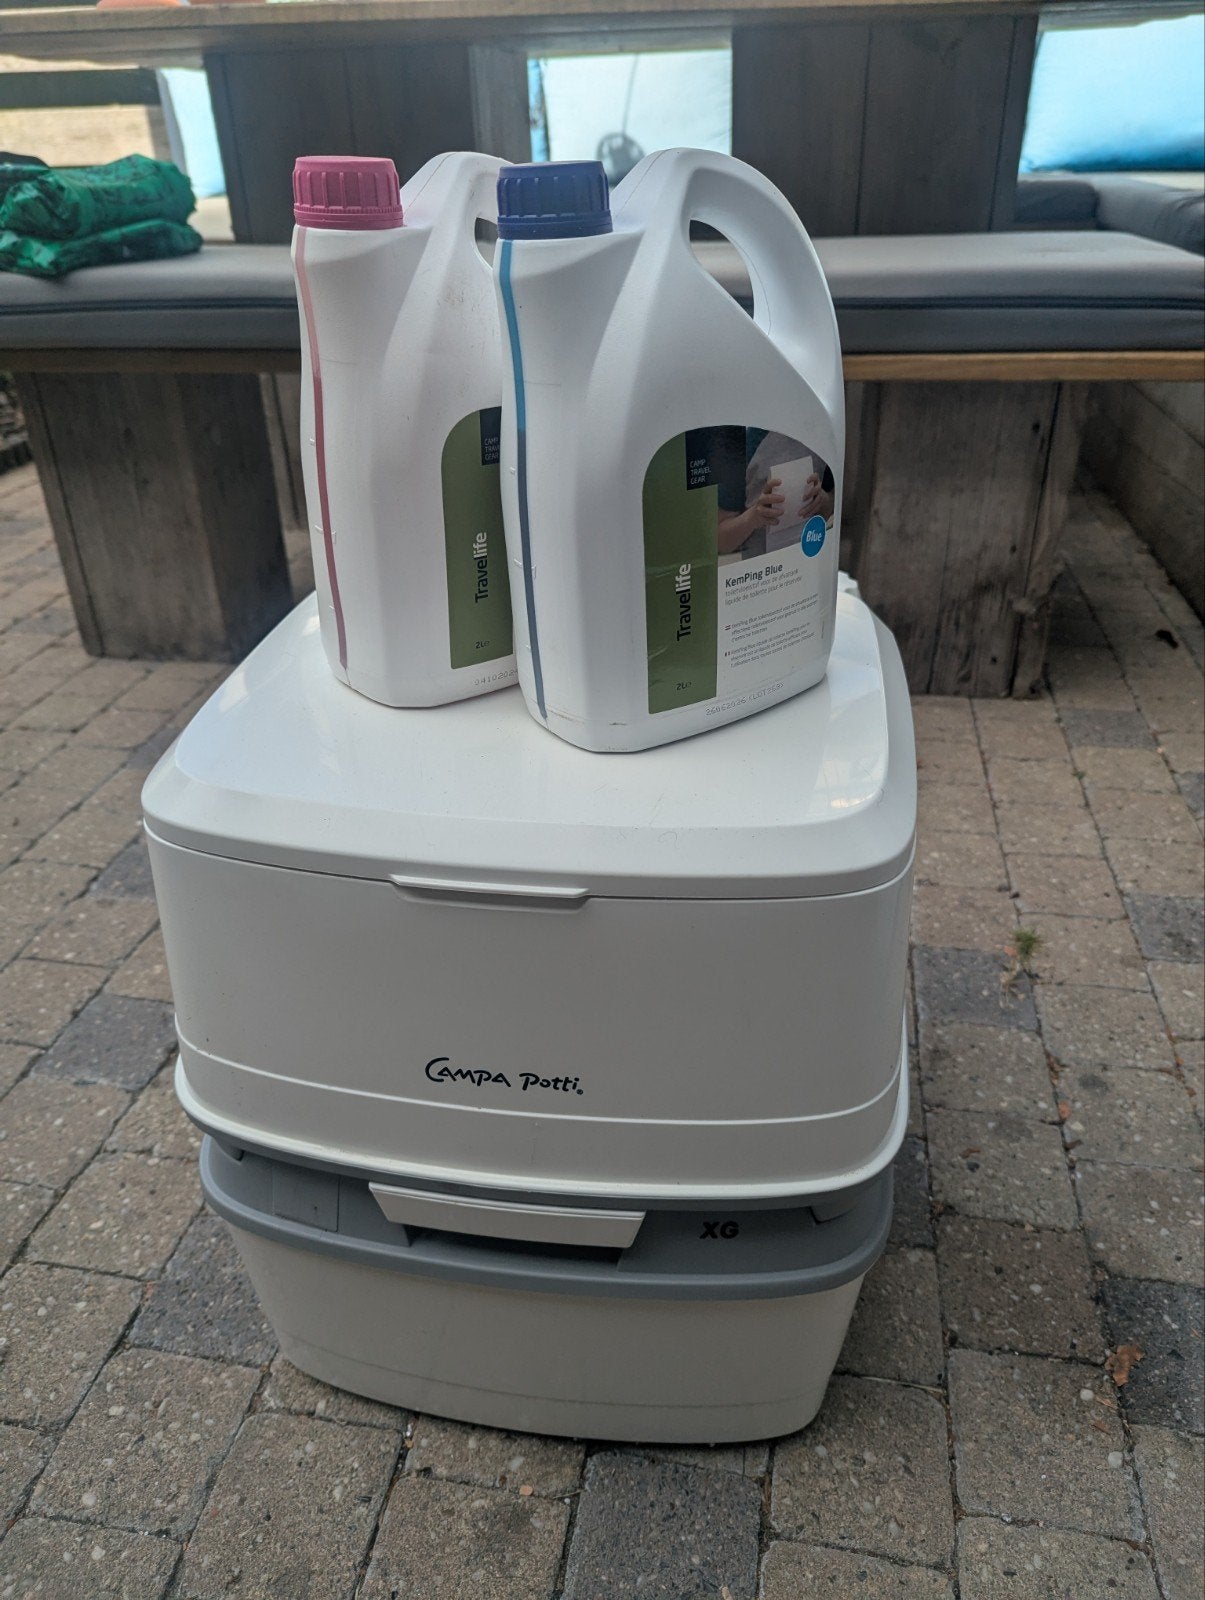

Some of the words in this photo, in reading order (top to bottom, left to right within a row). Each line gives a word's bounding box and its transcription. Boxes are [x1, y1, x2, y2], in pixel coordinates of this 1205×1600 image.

[690, 458, 706, 468] CAMP
[690, 466, 712, 476] TRAVEL
[690, 475, 706, 485] GEAR
[806, 530, 823, 542] Blue
[473, 531, 489, 603] Travellife
[725, 571, 763, 588] KemPing
[765, 564, 783, 576] Blue
[675, 563, 692, 642] Travellife
[699, 1220, 740, 1240] XG
